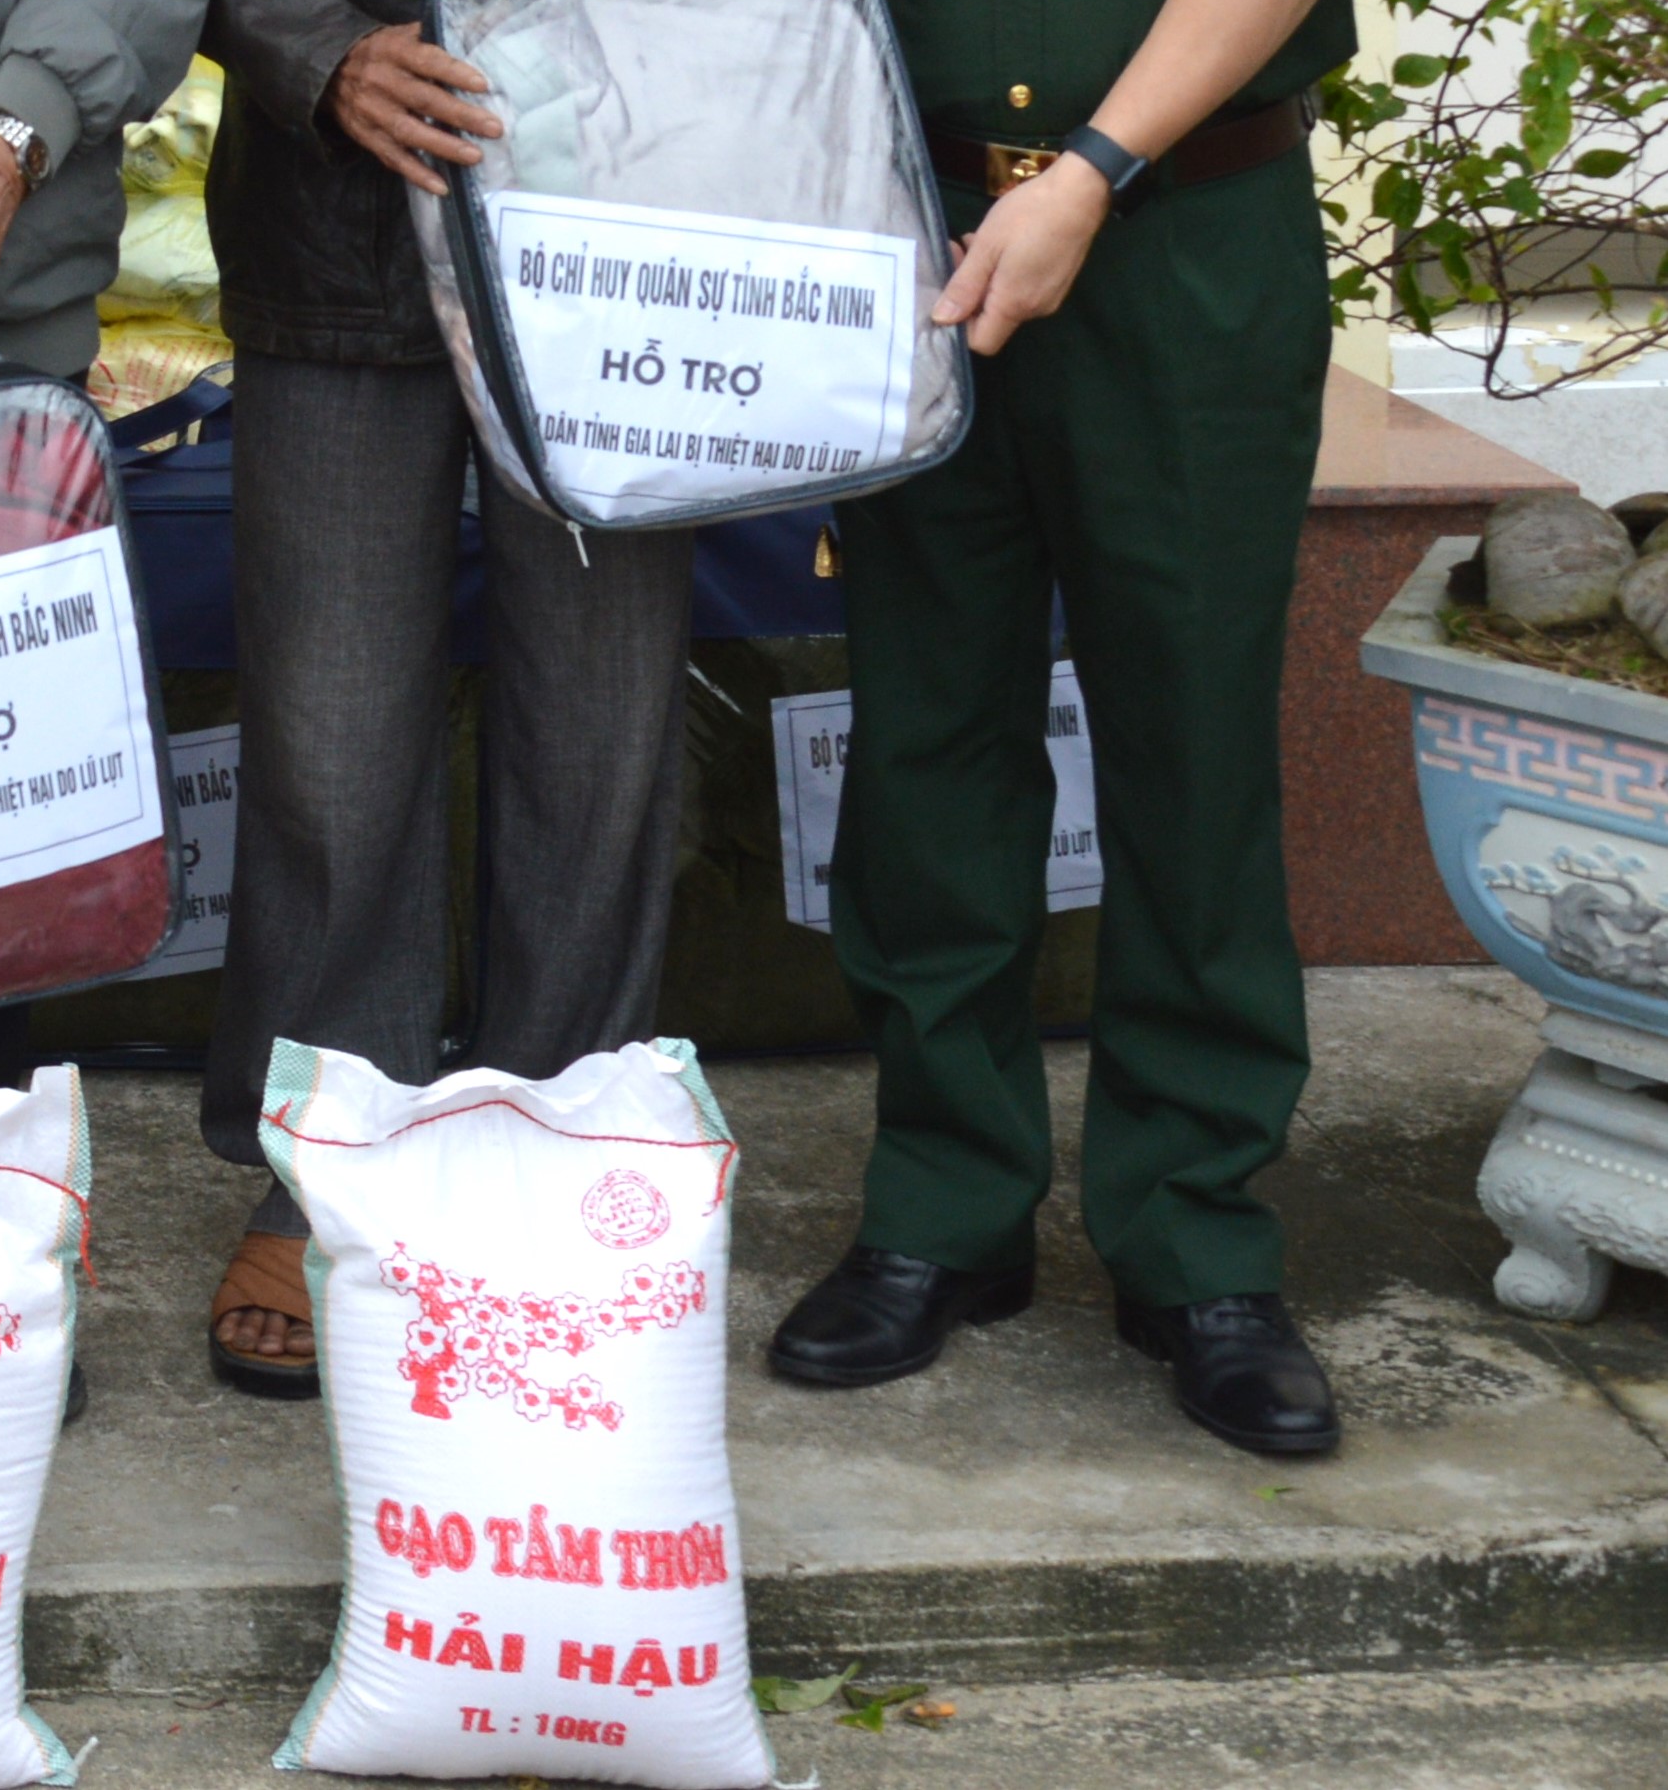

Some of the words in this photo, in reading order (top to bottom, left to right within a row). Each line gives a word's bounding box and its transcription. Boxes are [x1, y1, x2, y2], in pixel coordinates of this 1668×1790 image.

[520, 241, 545, 299] BỘ
[551, 240, 588, 295] CHỈ
[590, 256, 632, 301] HUY
[637, 257, 693, 309] QUÂN
[697, 269, 729, 322] SỰ
[733, 260, 777, 318] TỈNH
[781, 266, 822, 324] BẮC
[826, 285, 876, 329] NINH
[600, 338, 666, 386] HỖ
[681, 358, 764, 407] TRỢ
[545, 413, 579, 448] DÂN
[583, 412, 619, 451] TỈNH
[624, 426, 651, 455] GIA
[655, 429, 680, 459] LAI
[684, 432, 701, 469] BỊ
[706, 431, 749, 473] THIỆT
[753, 440, 780, 476] HẠI
[783, 443, 806, 471] DO
[809, 440, 830, 473] LŨ
[809, 728, 831, 775] BỘ
[374, 1498, 476, 1577] GẠO
[484, 1503, 604, 1587] TÁM
[610, 1521, 729, 1591] THƠM
[383, 1610, 525, 1674] HẢI
[557, 1638, 719, 1697] HẬU
[459, 1707, 504, 1735] TL
[534, 1713, 626, 1747] 10KG
